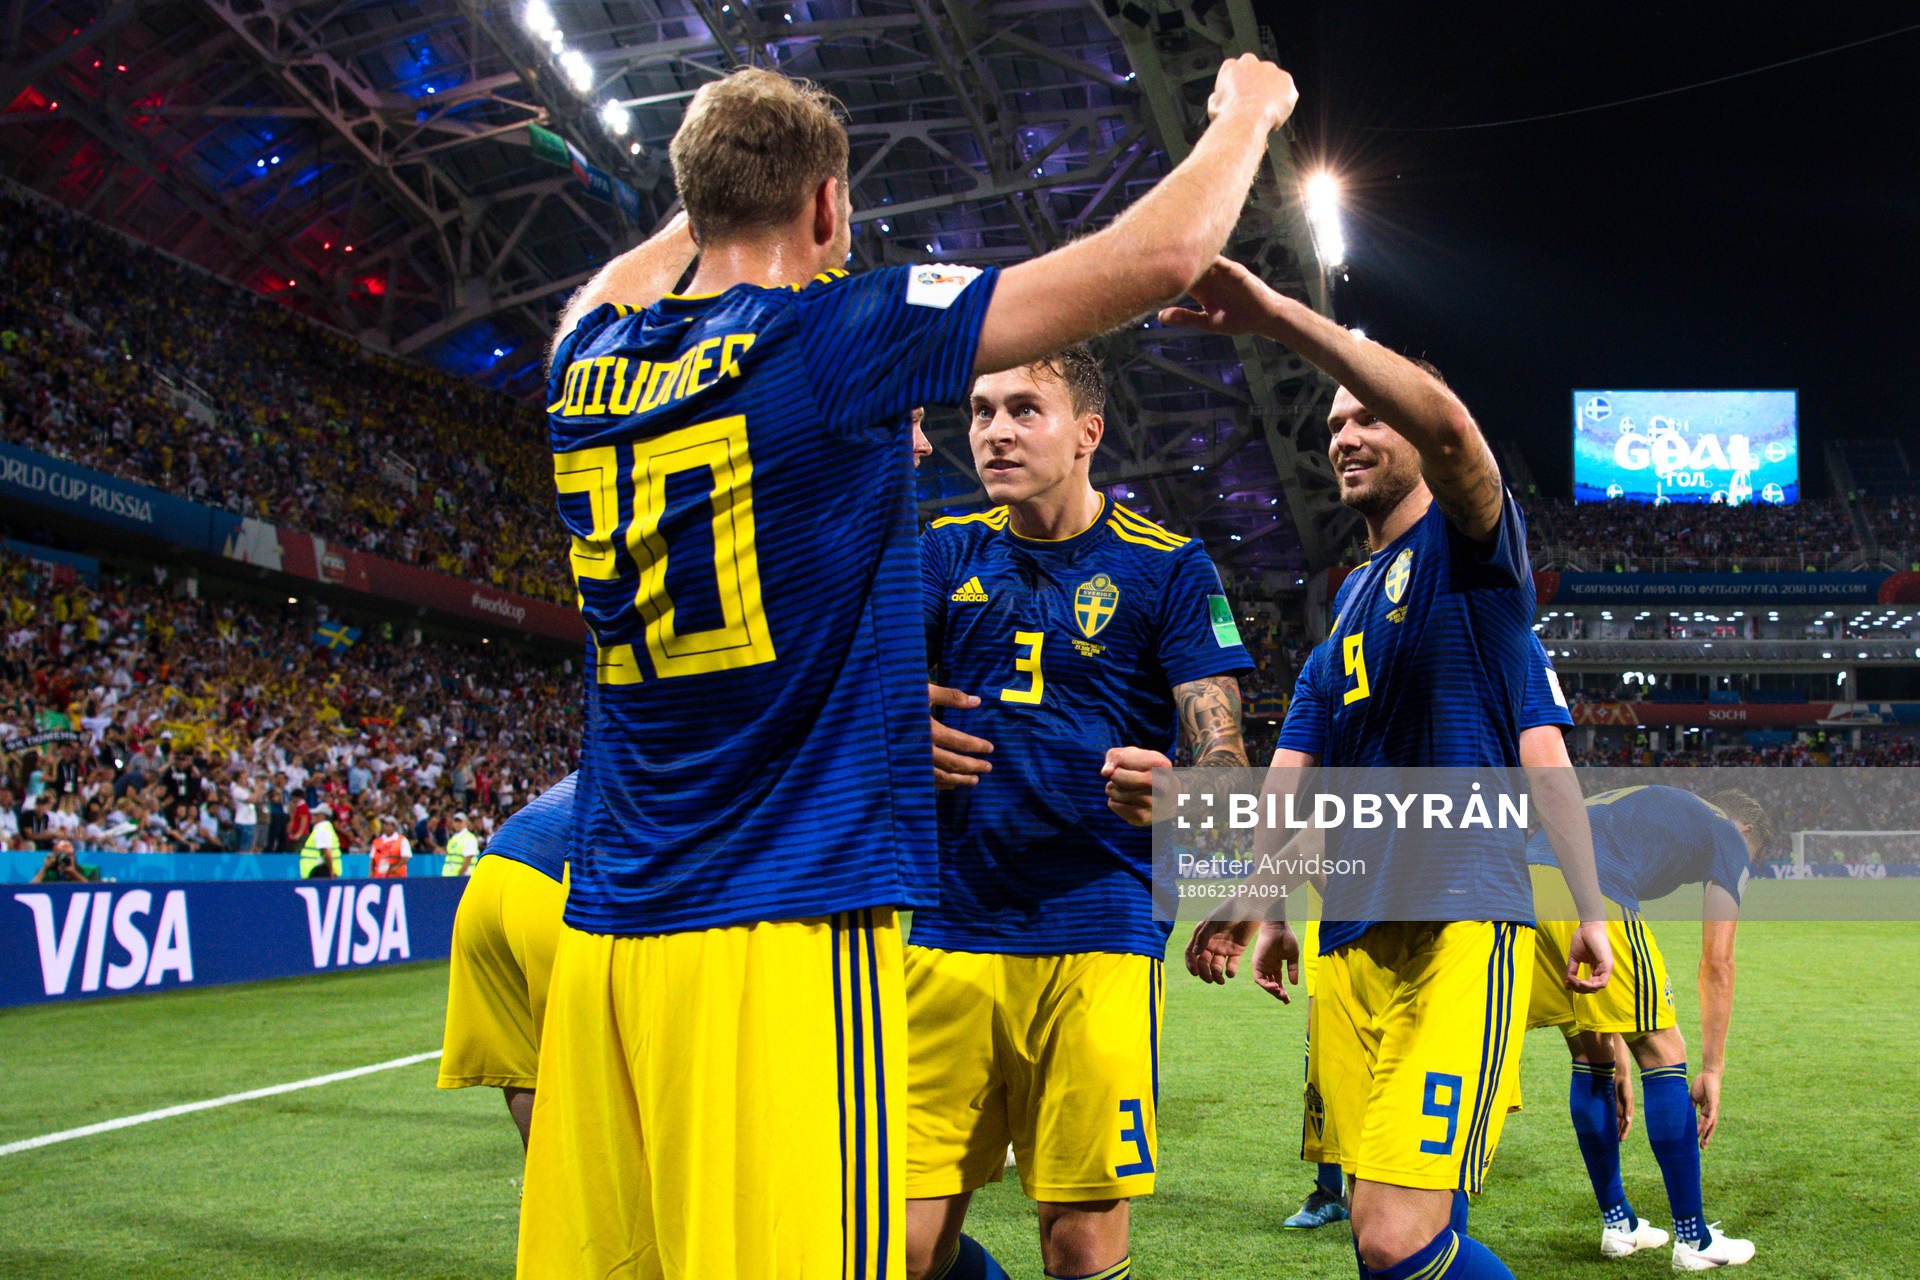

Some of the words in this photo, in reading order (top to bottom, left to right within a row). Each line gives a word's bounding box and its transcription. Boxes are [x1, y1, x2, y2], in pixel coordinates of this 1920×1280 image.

[1614, 432, 1760, 471] GOAL
[48, 472, 87, 501] CUP
[90, 484, 152, 524] RUSSIA
[553, 414, 777, 686] 20
[951, 593, 989, 602] adidas
[1571, 584, 1640, 594] ЧЕМПИОНАТ
[1680, 584, 1696, 594] ПО
[1698, 584, 1752, 594] ФУТБОЛУ
[1753, 584, 1778, 594] FIFA
[1819, 584, 1867, 594] РОССИИ
[1000, 630, 1044, 704] 3
[1343, 631, 1370, 706] 9
[1709, 710, 1746, 720] SOCHI
[1770, 864, 1814, 880] VISA
[1844, 864, 1887, 880] VISA
[14, 889, 194, 996] VISA
[295, 883, 410, 968] VISA
[1114, 1099, 1155, 1178] 3
[1420, 1072, 1462, 1155] 9
